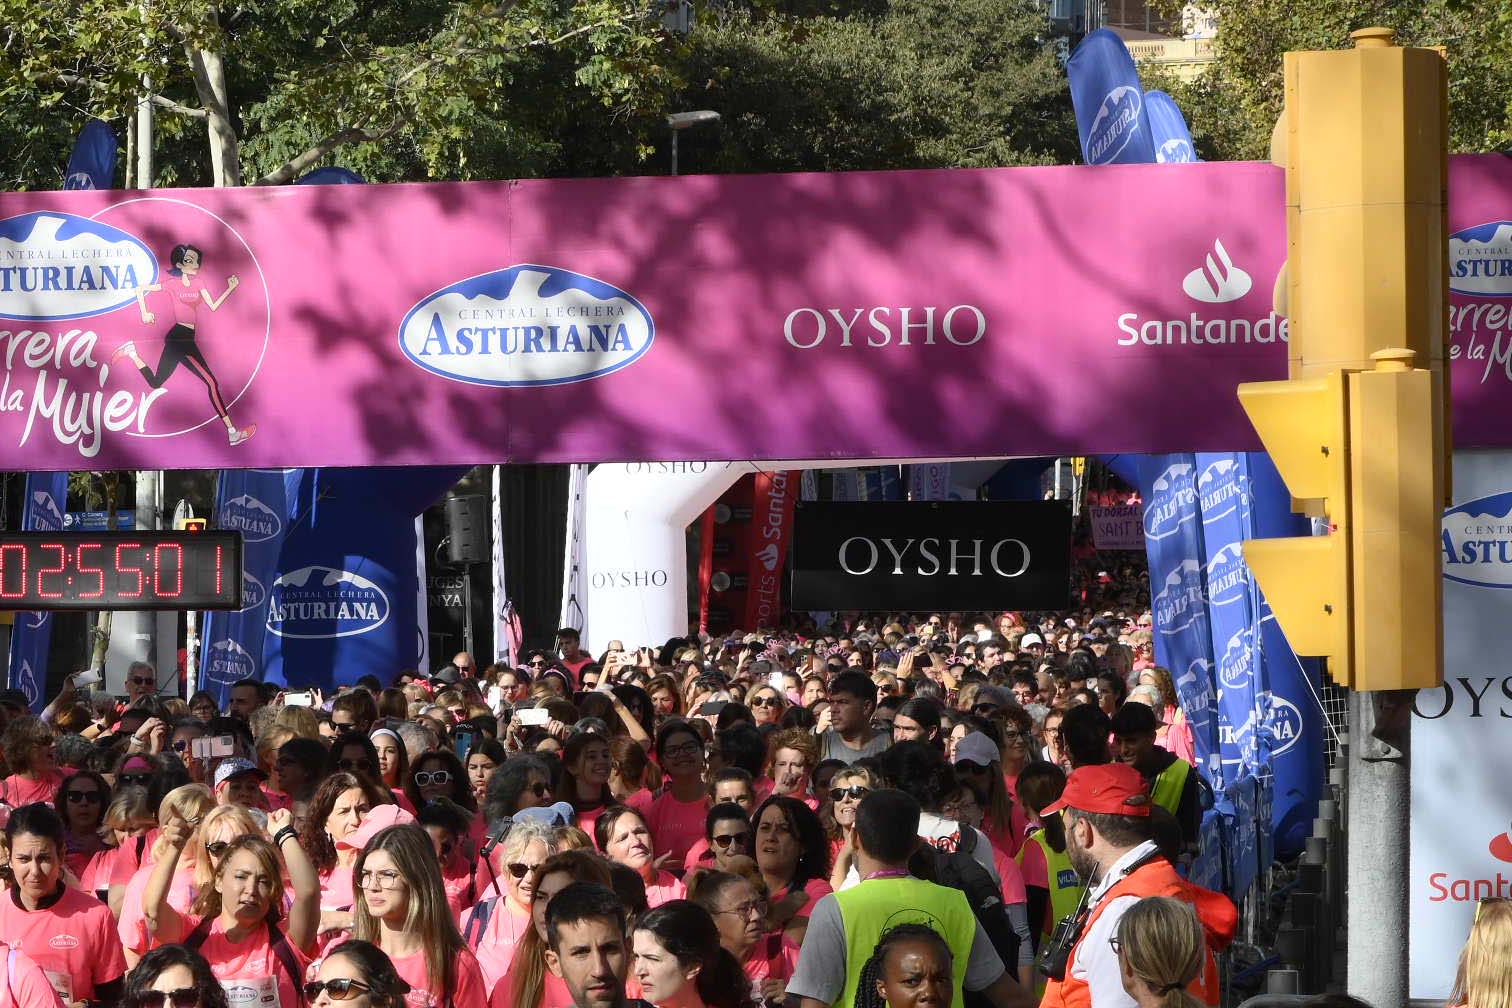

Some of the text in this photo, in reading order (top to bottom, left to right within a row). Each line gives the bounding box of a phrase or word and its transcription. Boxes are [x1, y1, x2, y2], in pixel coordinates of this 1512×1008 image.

[61, 248, 134, 259] LECHERA
[1458, 248, 1511, 256] CENTRAL
[458, 305, 625, 320] CENTRAL LECHERA
[419, 311, 634, 356] ASTURIANA
[784, 304, 986, 350] OYSHO
[1117, 311, 1288, 346] Santande
[1467, 333, 1485, 359] la
[0, 371, 24, 412] la
[19, 364, 168, 458] Mujer
[763, 470, 788, 540] Santa
[838, 537, 1032, 579] OYSHO
[592, 570, 668, 590] OYSHO
[327, 591, 375, 599] LECHERA
[268, 596, 380, 622] ASTURIANA
[1429, 873, 1512, 902] Sant
